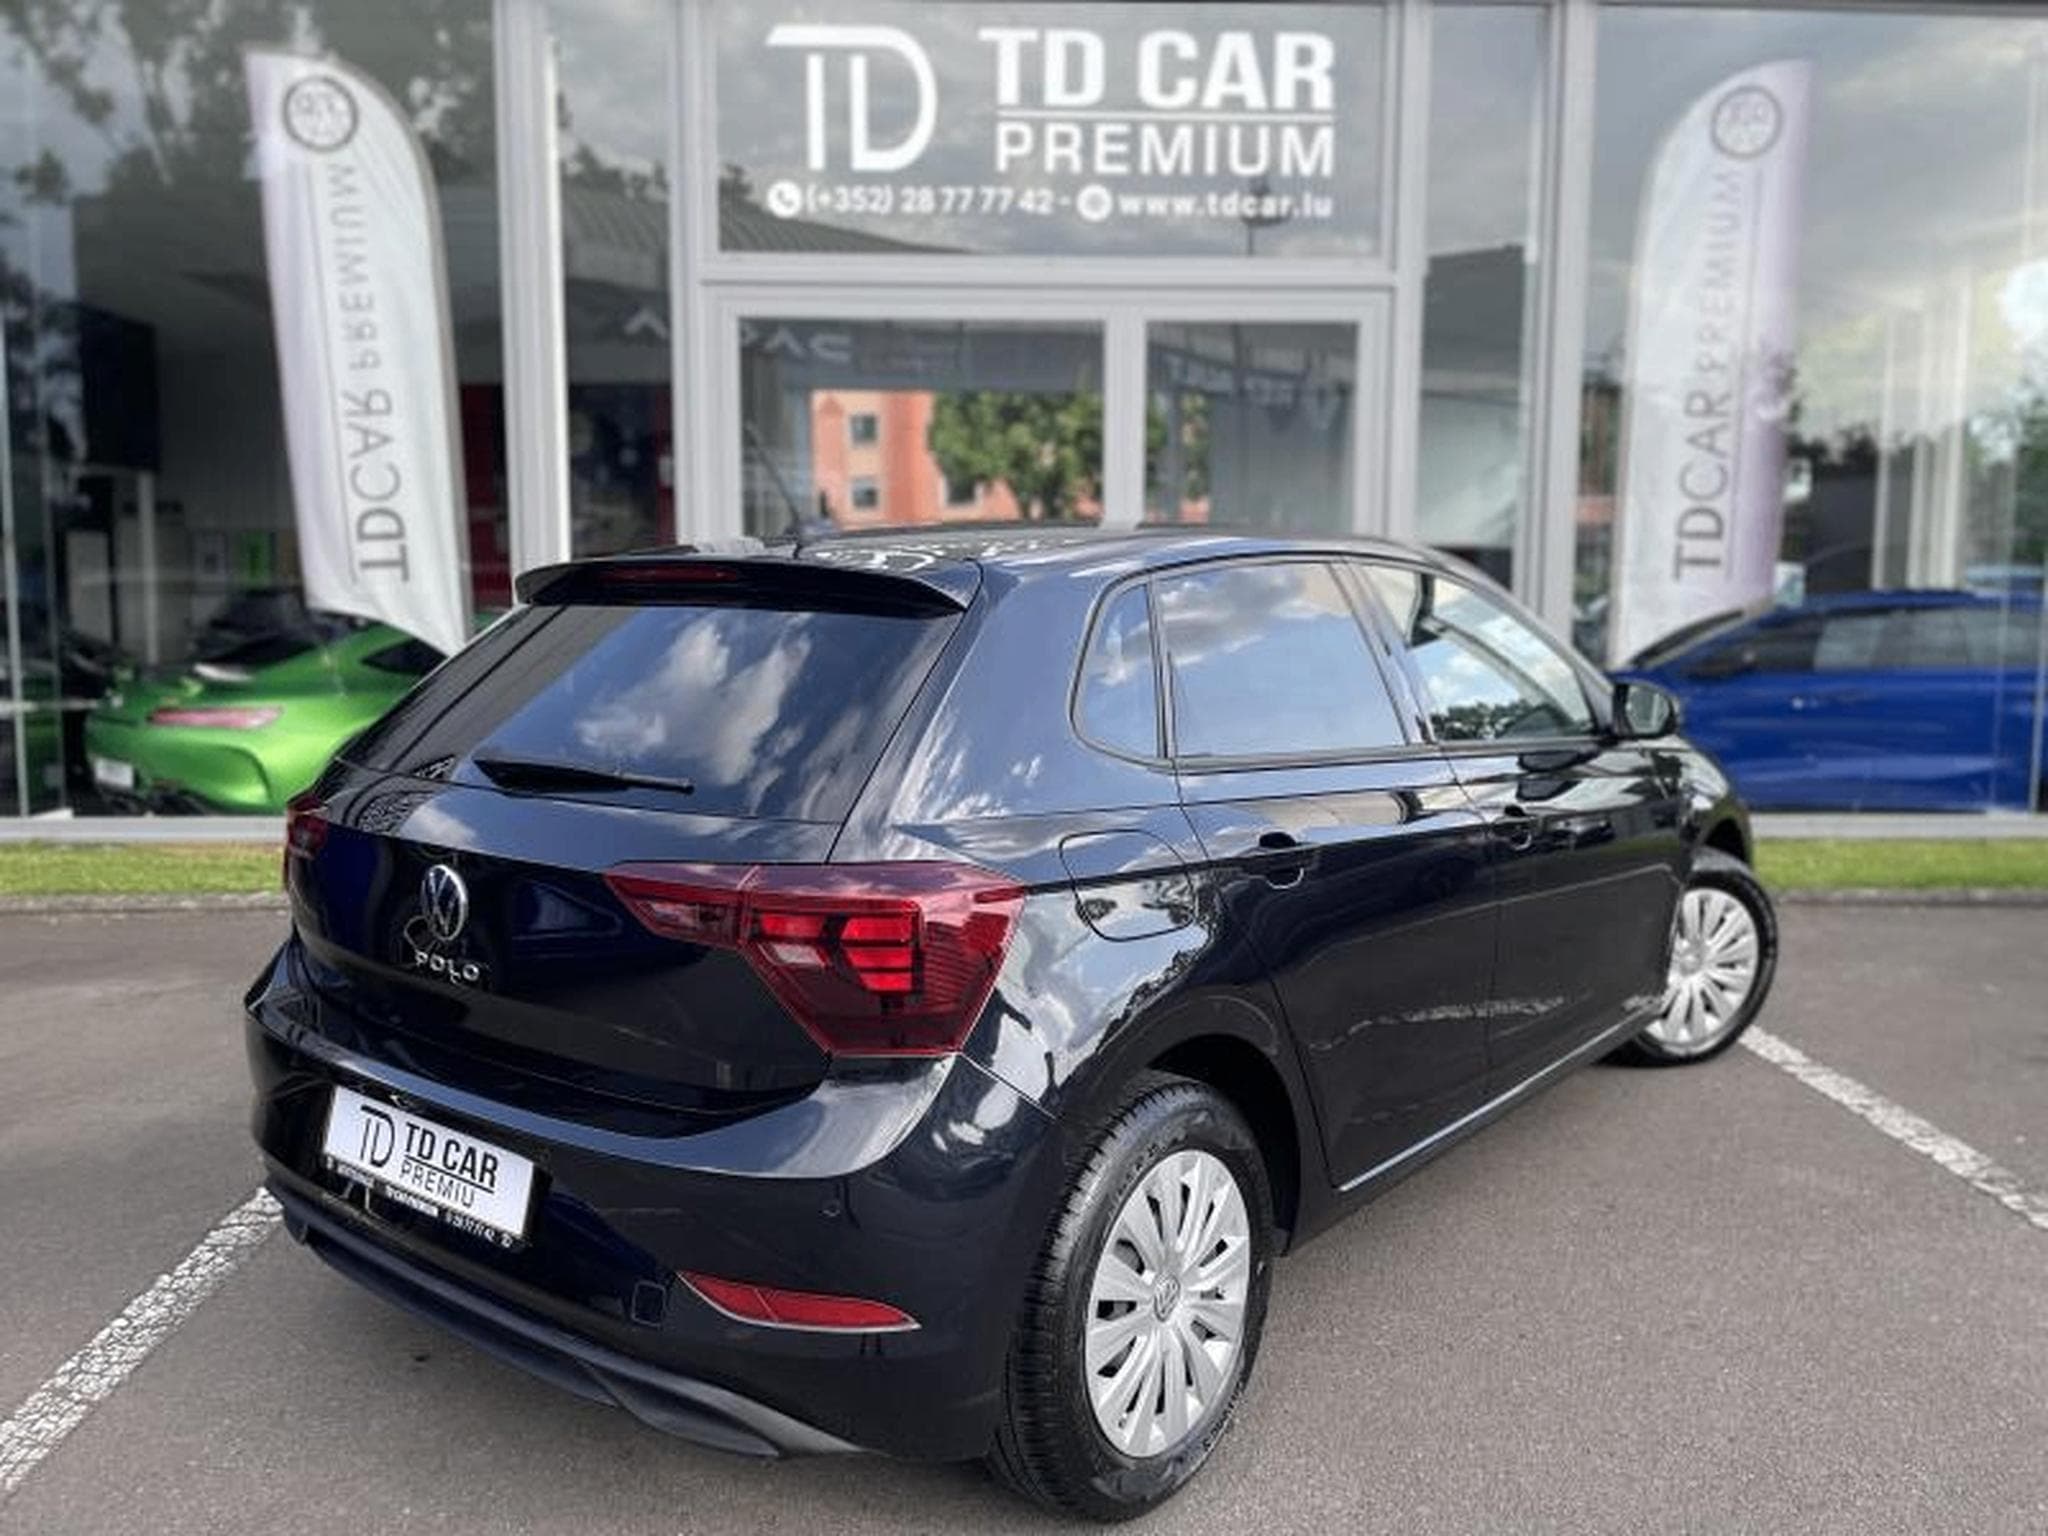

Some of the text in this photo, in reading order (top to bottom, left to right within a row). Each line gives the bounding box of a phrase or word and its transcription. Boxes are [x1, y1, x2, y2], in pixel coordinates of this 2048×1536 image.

[978, 27, 1335, 110] TD CAR
[996, 123, 1334, 177] PREMIUM
[1118, 191, 1333, 218] www.tdcar.lu
[1672, 388, 1733, 582] TDCAR
[414, 951, 480, 984] POLO
[404, 1122, 499, 1188] TD CAR
[400, 1159, 475, 1208] PREMIU
